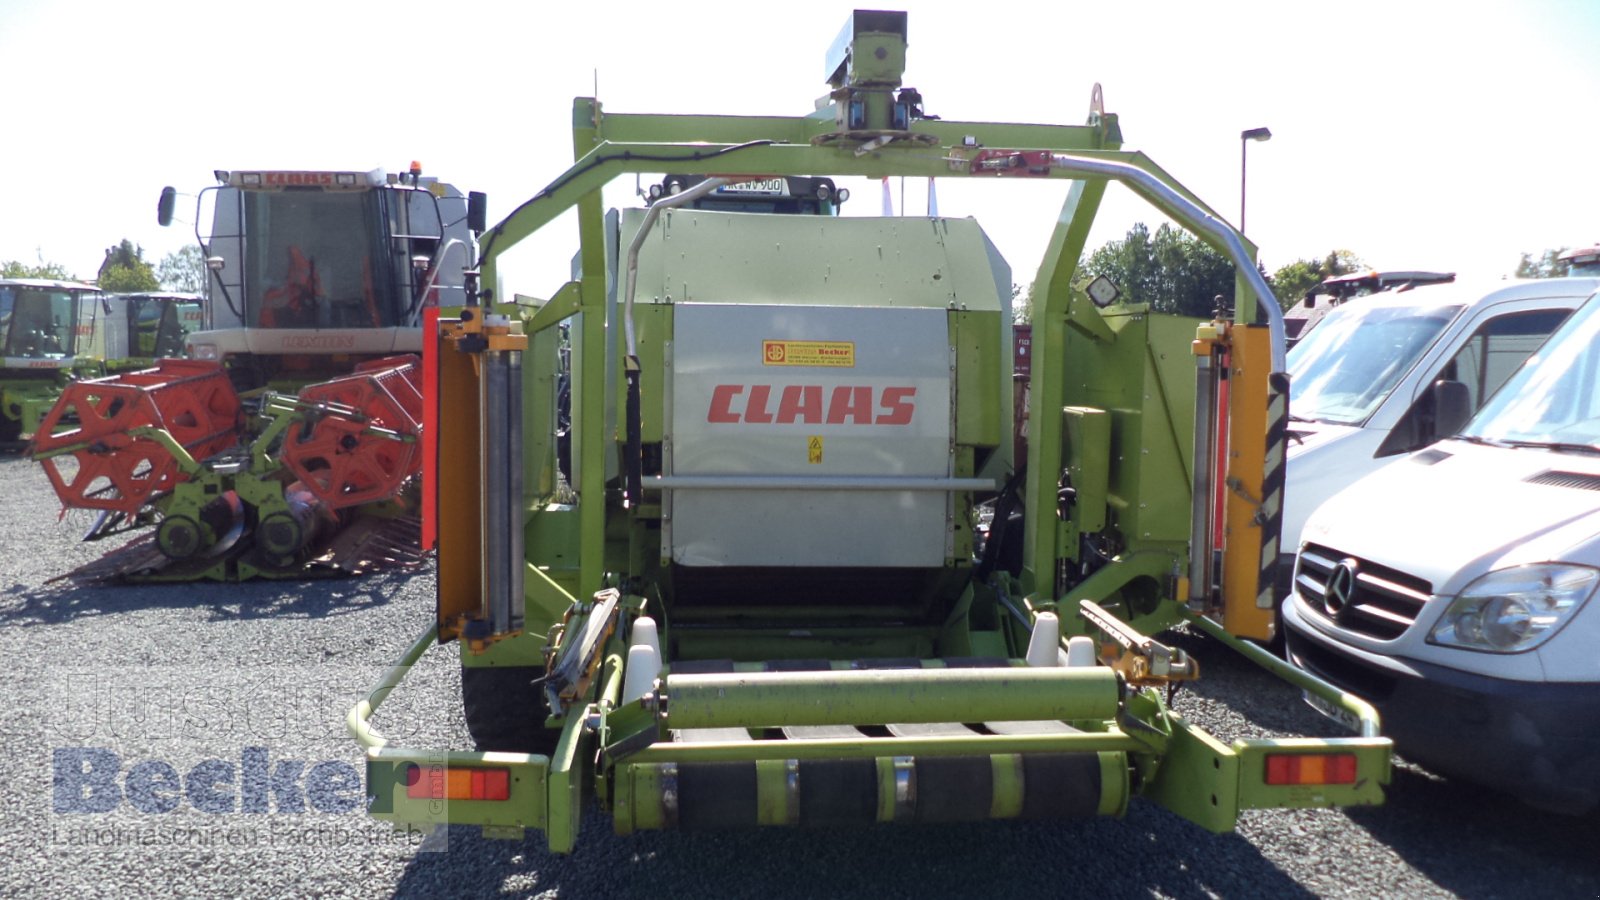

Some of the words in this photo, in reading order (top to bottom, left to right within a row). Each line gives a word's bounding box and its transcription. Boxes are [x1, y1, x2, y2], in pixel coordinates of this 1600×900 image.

[266, 172, 332, 185] CLAAS
[761, 179, 781, 190] 900
[707, 384, 917, 425] CLAAS
